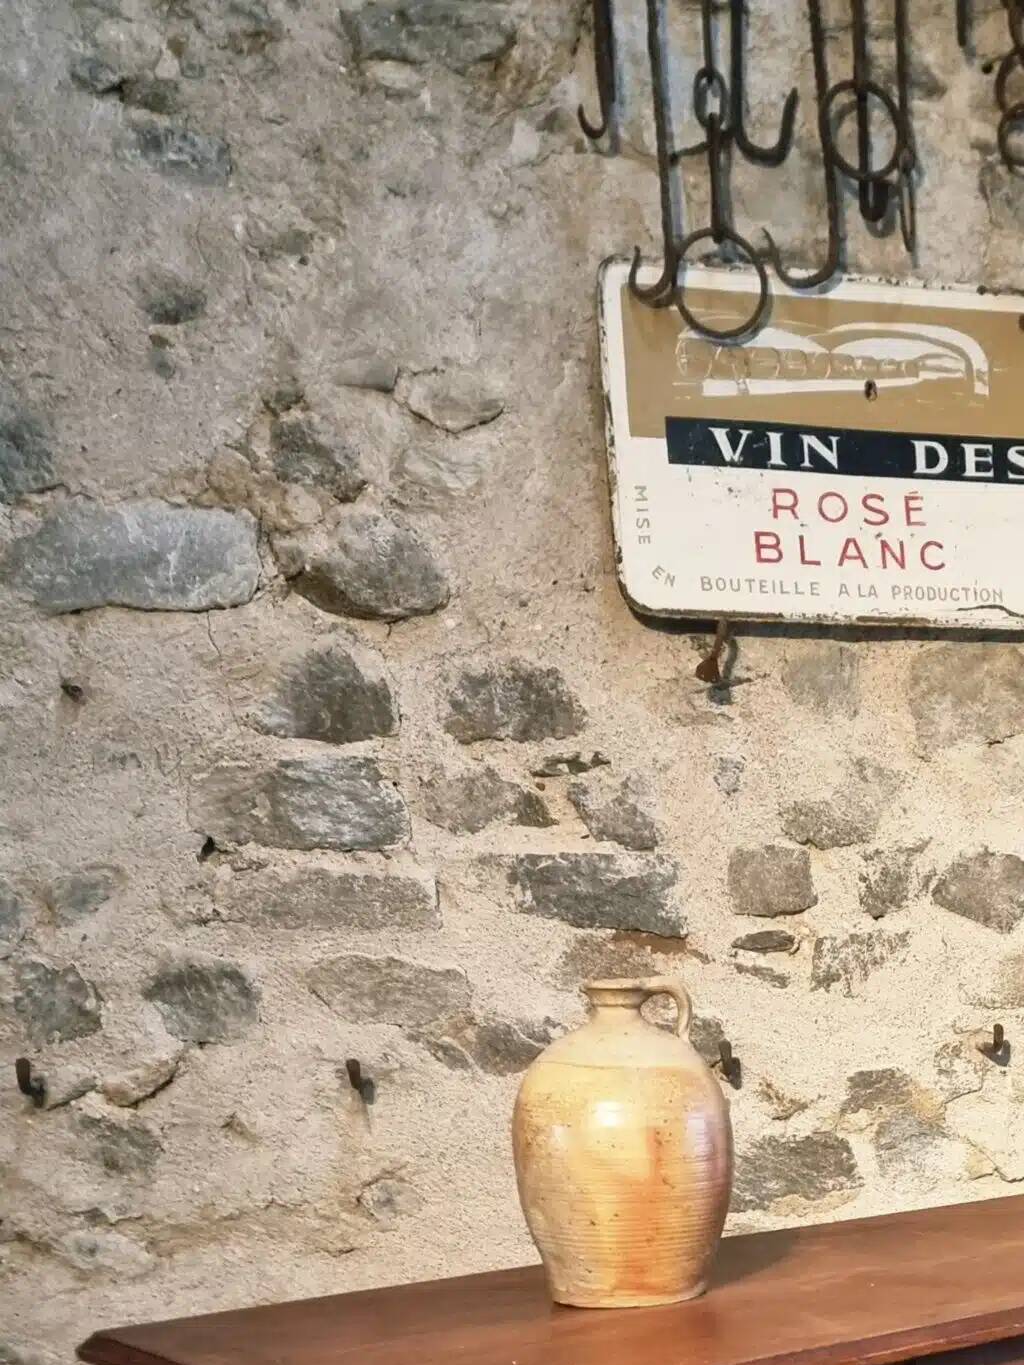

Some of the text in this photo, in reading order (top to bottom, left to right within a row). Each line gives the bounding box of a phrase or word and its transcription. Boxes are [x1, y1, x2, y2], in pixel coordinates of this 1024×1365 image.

[708, 426, 840, 470] VIN
[771, 488, 927, 526] ROSÉ
[634, 485, 651, 545] MISE
[651, 565, 677, 588] EN
[700, 575, 821, 597] BOUTEILLE
[857, 583, 878, 599] LA
[891, 584, 1004, 603] PRODUCTION
[754, 531, 946, 571] BLANC
